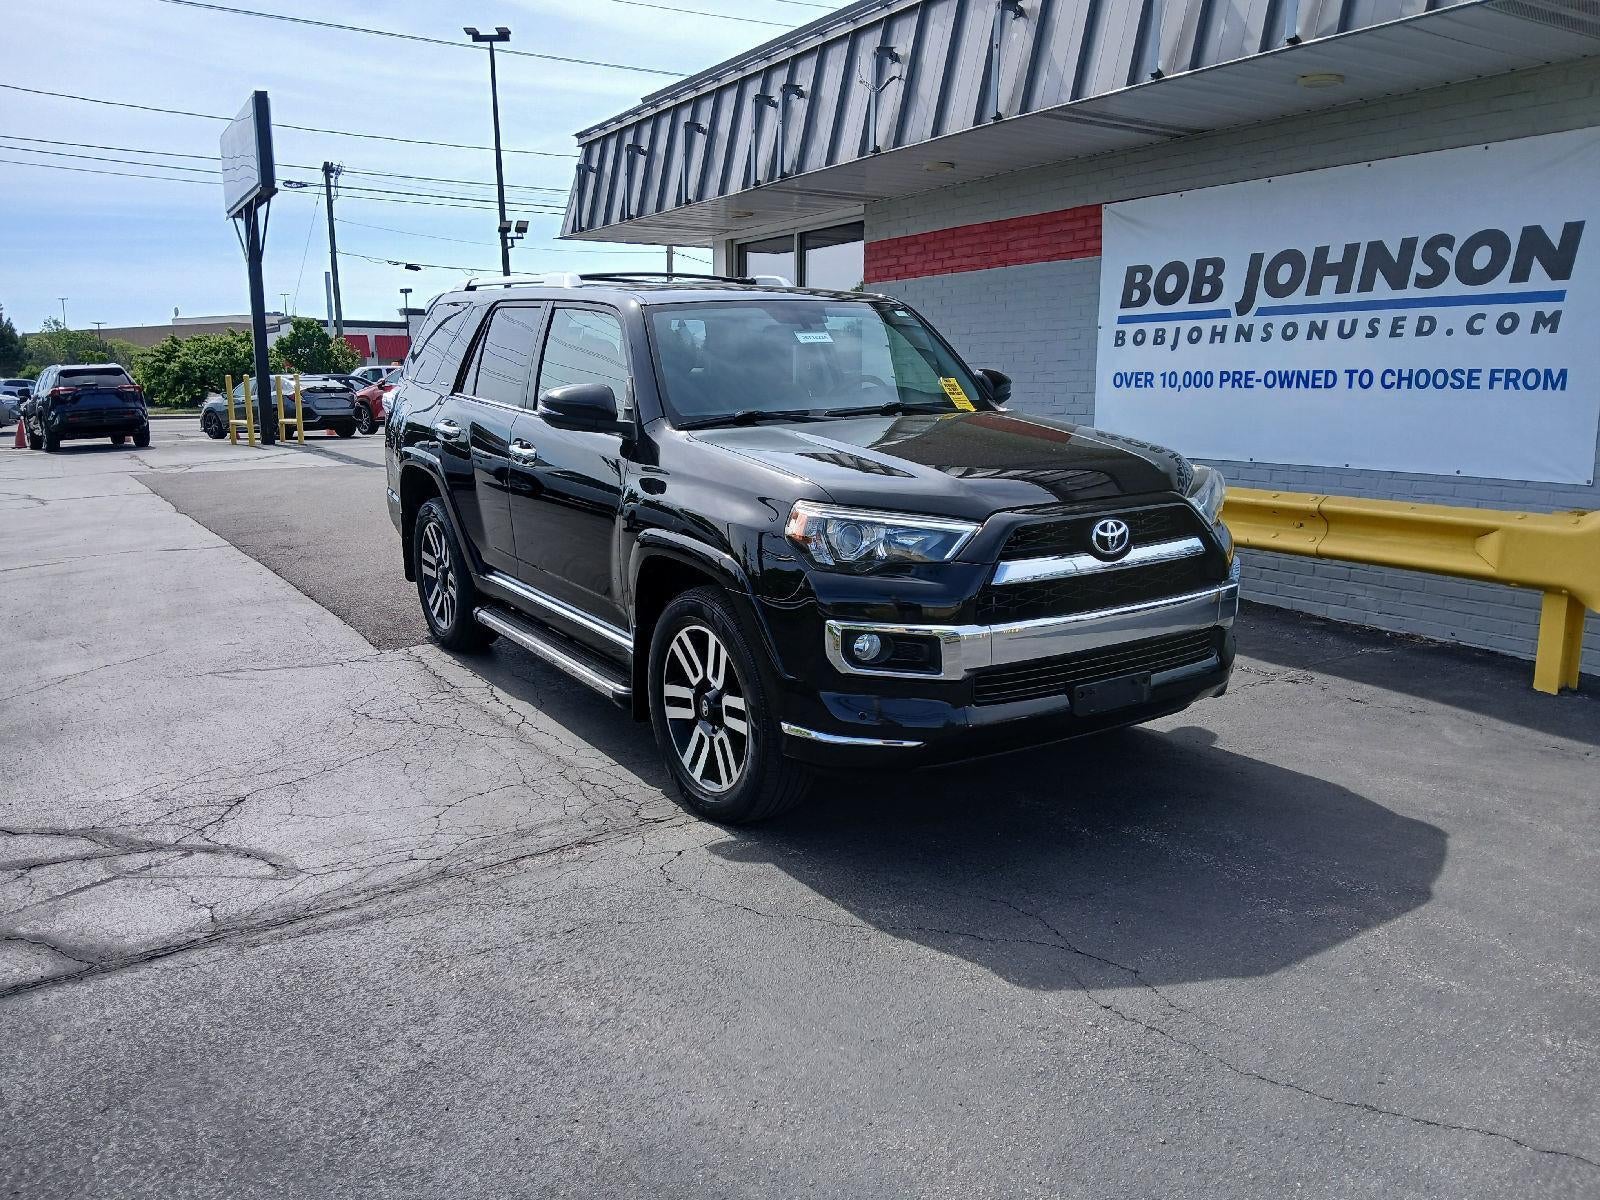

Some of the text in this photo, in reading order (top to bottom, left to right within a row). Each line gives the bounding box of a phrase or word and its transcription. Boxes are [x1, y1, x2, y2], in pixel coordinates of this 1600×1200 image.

[1119, 220, 1587, 317] BOB JOHNSON
[1113, 309, 1563, 351] BOBJOHNSONUSED.COM
[1112, 368, 1569, 393] OVER 10,000 PRE-OWNED TO CHOOSE FROM
